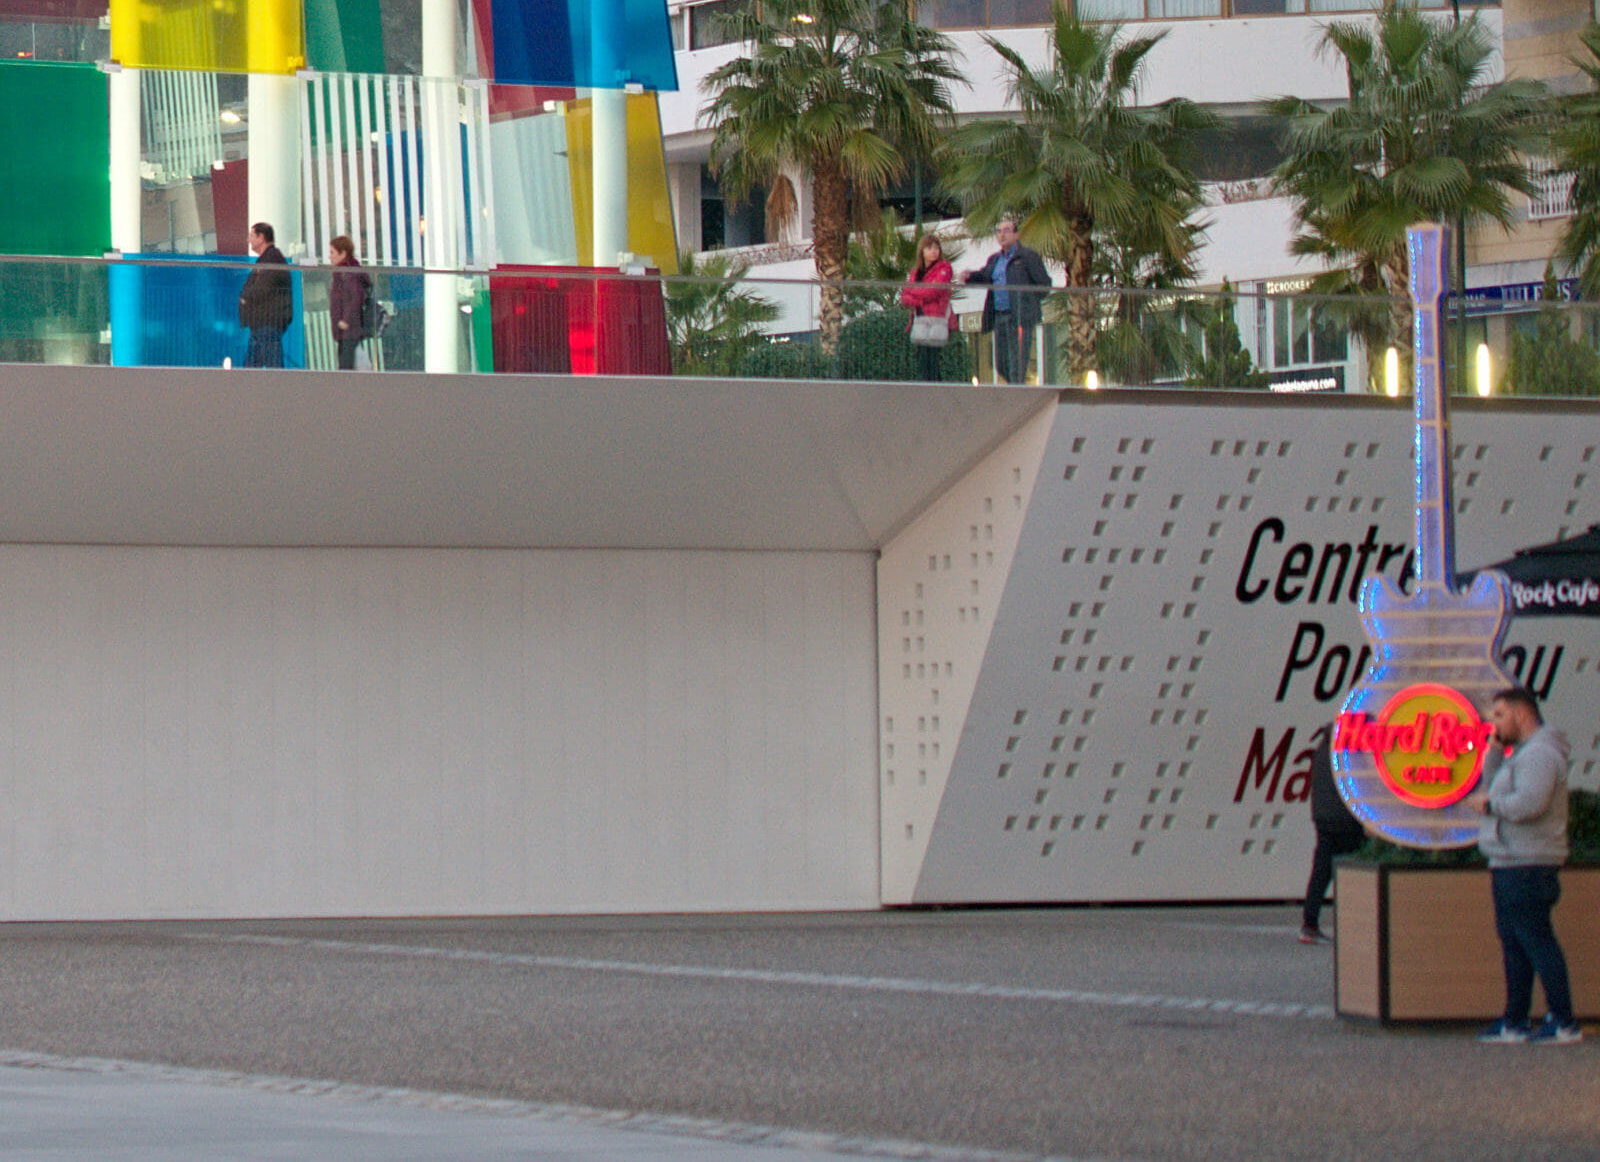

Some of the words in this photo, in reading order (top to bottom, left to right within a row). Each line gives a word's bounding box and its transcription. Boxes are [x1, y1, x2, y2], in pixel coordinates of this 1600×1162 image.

[1512, 580, 1555, 608] Rock
[1334, 711, 1427, 753] Hard
[1428, 710, 1513, 762] Roc
[1402, 764, 1452, 784] CAFE
